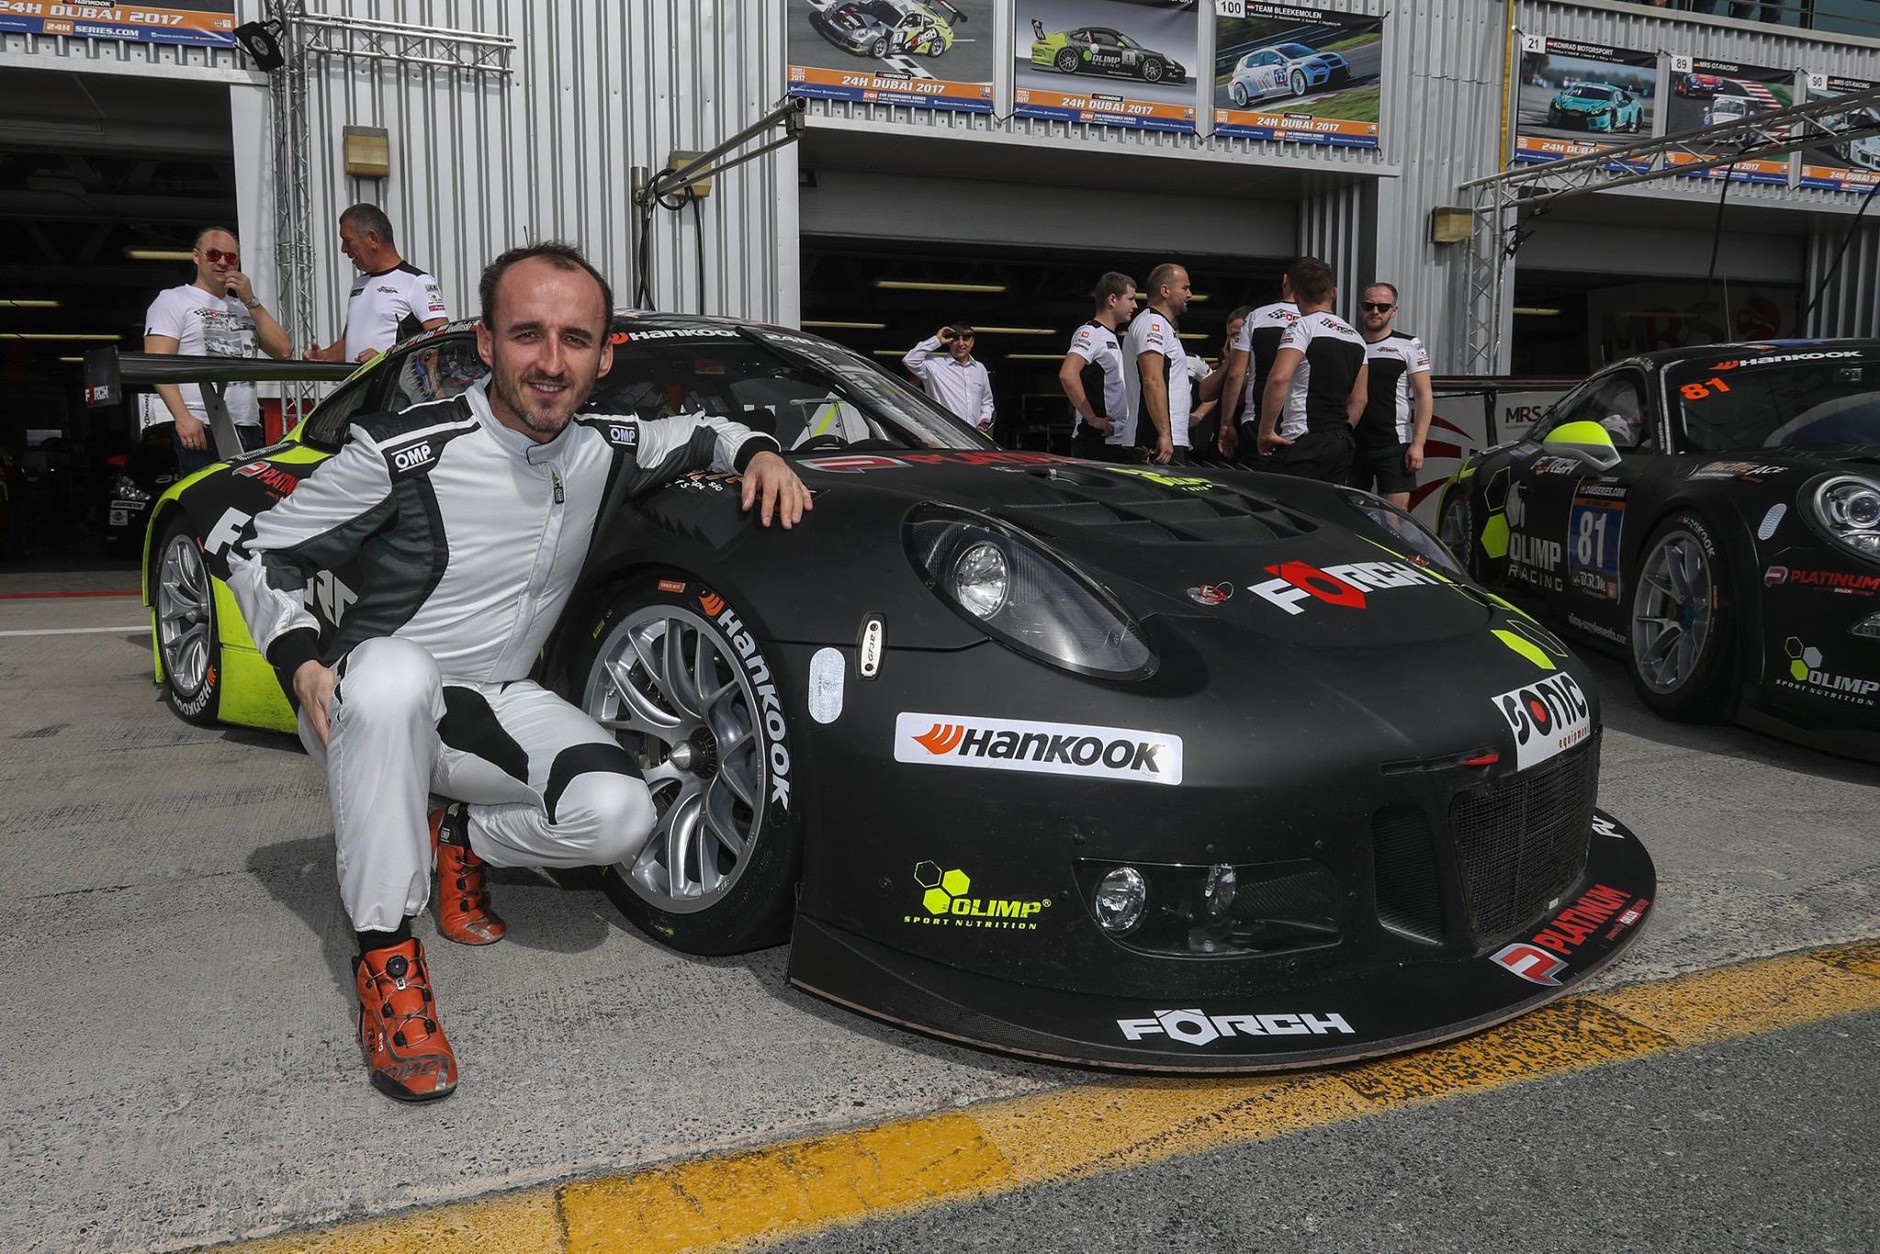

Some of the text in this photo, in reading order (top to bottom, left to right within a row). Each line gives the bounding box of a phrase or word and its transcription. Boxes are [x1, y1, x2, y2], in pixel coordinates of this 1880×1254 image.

[0, 1, 183, 25] 24H DUBAI 2017
[1221, 2, 1241, 13] 100
[1255, 5, 1273, 13] TEAM
[1274, 7, 1322, 19] BLEEKEMOLEN
[46, 23, 71, 31] 24H
[75, 26, 139, 37] SERIES.COM
[1528, 38, 1539, 49] 21
[1554, 42, 1577, 51] KONRAD
[1577, 45, 1614, 56] MOTORSPORT
[1676, 58, 1687, 70] 89
[1699, 61, 1738, 72] MRS GT-RACING
[842, 75, 945, 94] 24H DUBAI 2017
[1812, 77, 1823, 87] 90
[1834, 79, 1846, 87] MRS
[1847, 81, 1870, 89] GT-RACING
[1062, 97, 1153, 115] 24H DUBAI 2017
[1257, 116, 1340, 132] 24H DUBAI 2017
[1541, 142, 1564, 152] 24H
[1741, 162, 1760, 170] 2017
[1829, 171, 1846, 179] 24H
[1847, 173, 1870, 182] DUBAI
[1680, 377, 1730, 400] 81
[1505, 406, 1542, 423] MRS
[610, 427, 635, 441] OMP
[394, 444, 432, 468] OMP
[1578, 511, 1607, 568] 81
[1509, 533, 1561, 571] OLIMP
[1508, 564, 1563, 592] RACING
[1791, 570, 1880, 590] PLATINUM
[1808, 670, 1880, 695] OLIMP
[1776, 679, 1874, 706] SPORT NUTRITION
[951, 898, 1042, 918] OLIMP
[904, 915, 1037, 930] SPORT NUTRITION
[1531, 884, 1632, 955] PLATINUM
